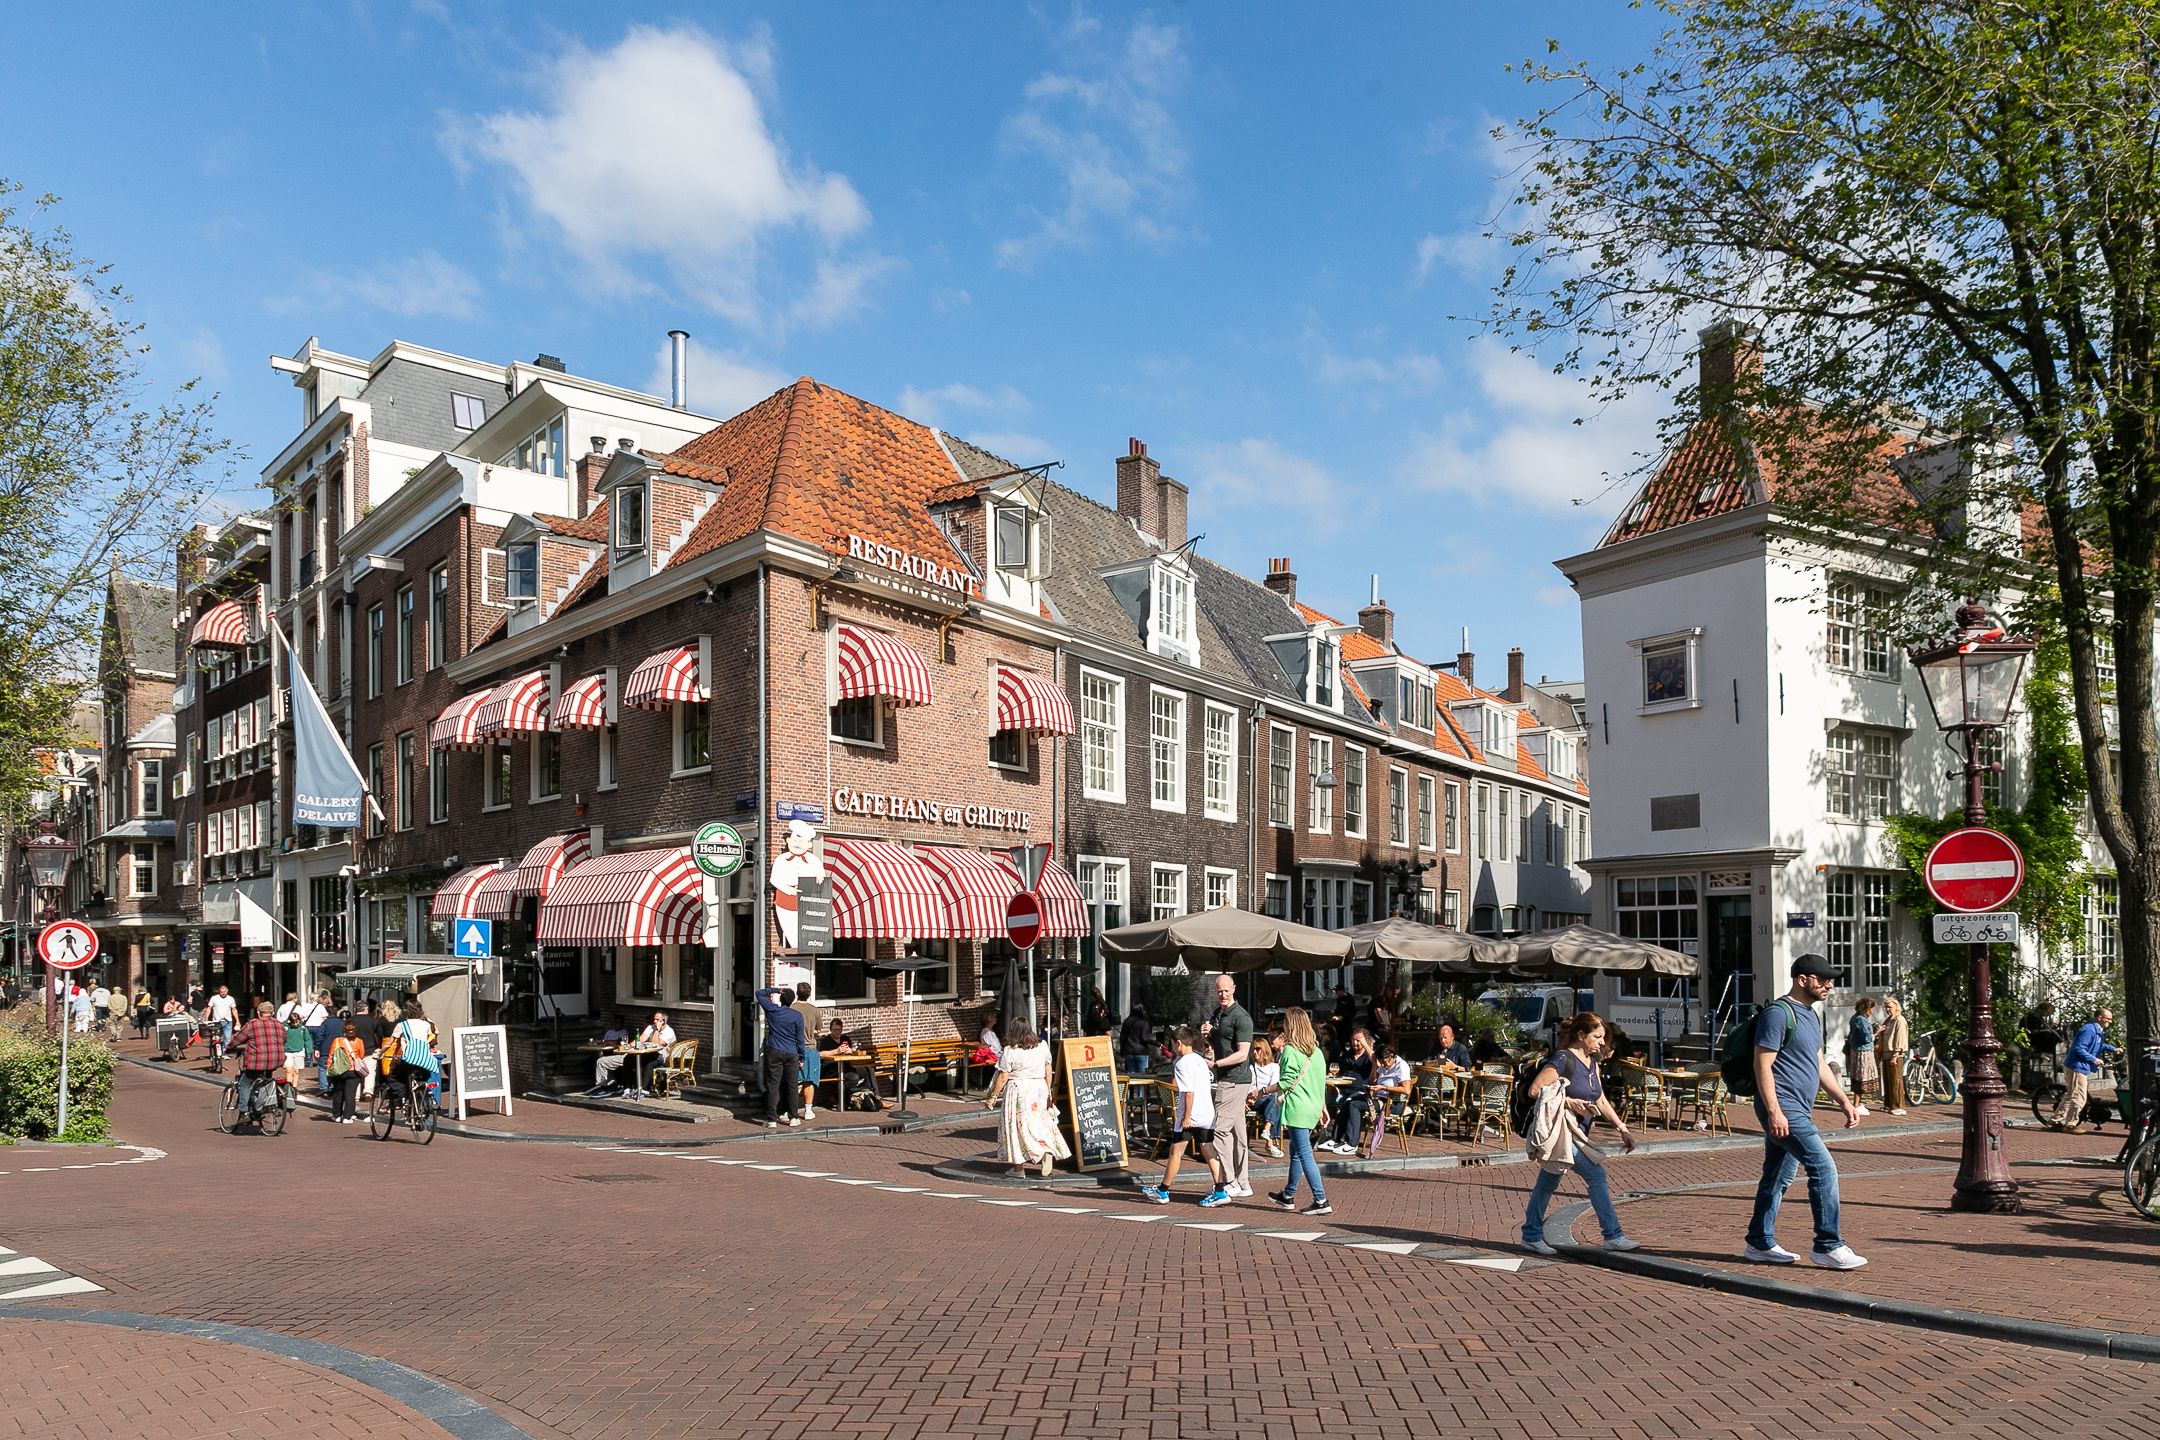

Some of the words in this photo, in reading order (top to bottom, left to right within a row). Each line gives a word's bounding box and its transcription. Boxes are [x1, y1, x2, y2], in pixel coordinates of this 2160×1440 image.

[849, 533, 978, 597] RESTAURANT
[297, 793, 360, 808] GALLERY
[297, 808, 357, 822] DELAIVE
[834, 788, 886, 816] CAFE
[889, 796, 940, 822] HANS
[943, 807, 961, 824] en
[964, 804, 1031, 831] GRIETJE
[699, 844, 741, 855] Heineken
[1940, 914, 2009, 923] uitgezonderd
[1758, 924, 1768, 935] 31
[544, 960, 571, 968] pstairs
